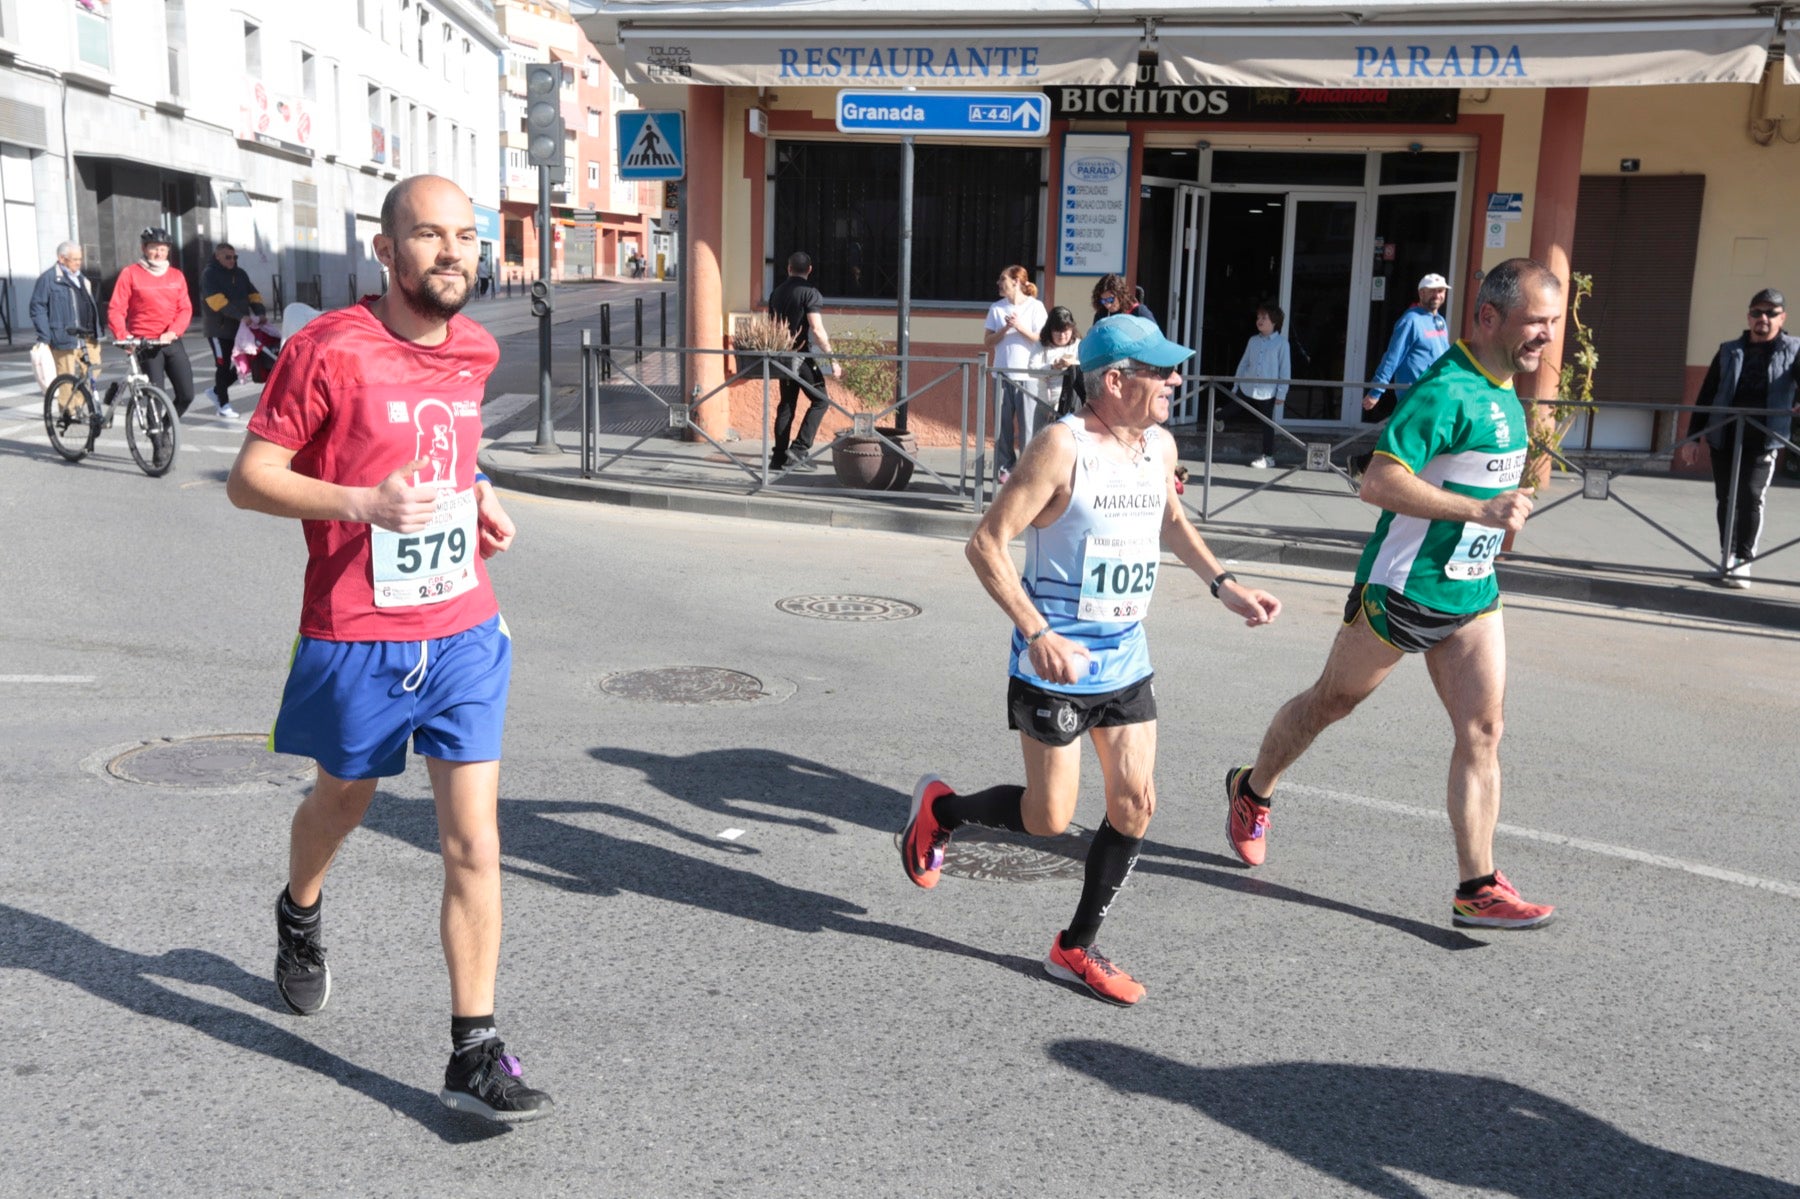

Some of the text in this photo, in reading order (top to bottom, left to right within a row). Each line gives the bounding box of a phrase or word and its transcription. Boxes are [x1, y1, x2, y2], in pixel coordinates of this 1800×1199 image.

[648, 46, 690, 55] TOLDOS
[779, 47, 1039, 78] RESTAURANTE
[1353, 45, 1527, 77] PARADA
[843, 103, 1009, 121] Granada A-44
[1060, 88, 1229, 114] BICHITOS
[1077, 167, 1116, 175] PARADA
[1093, 494, 1160, 509] MARACENA
[396, 527, 466, 574] 579
[1090, 562, 1156, 595] 1025
